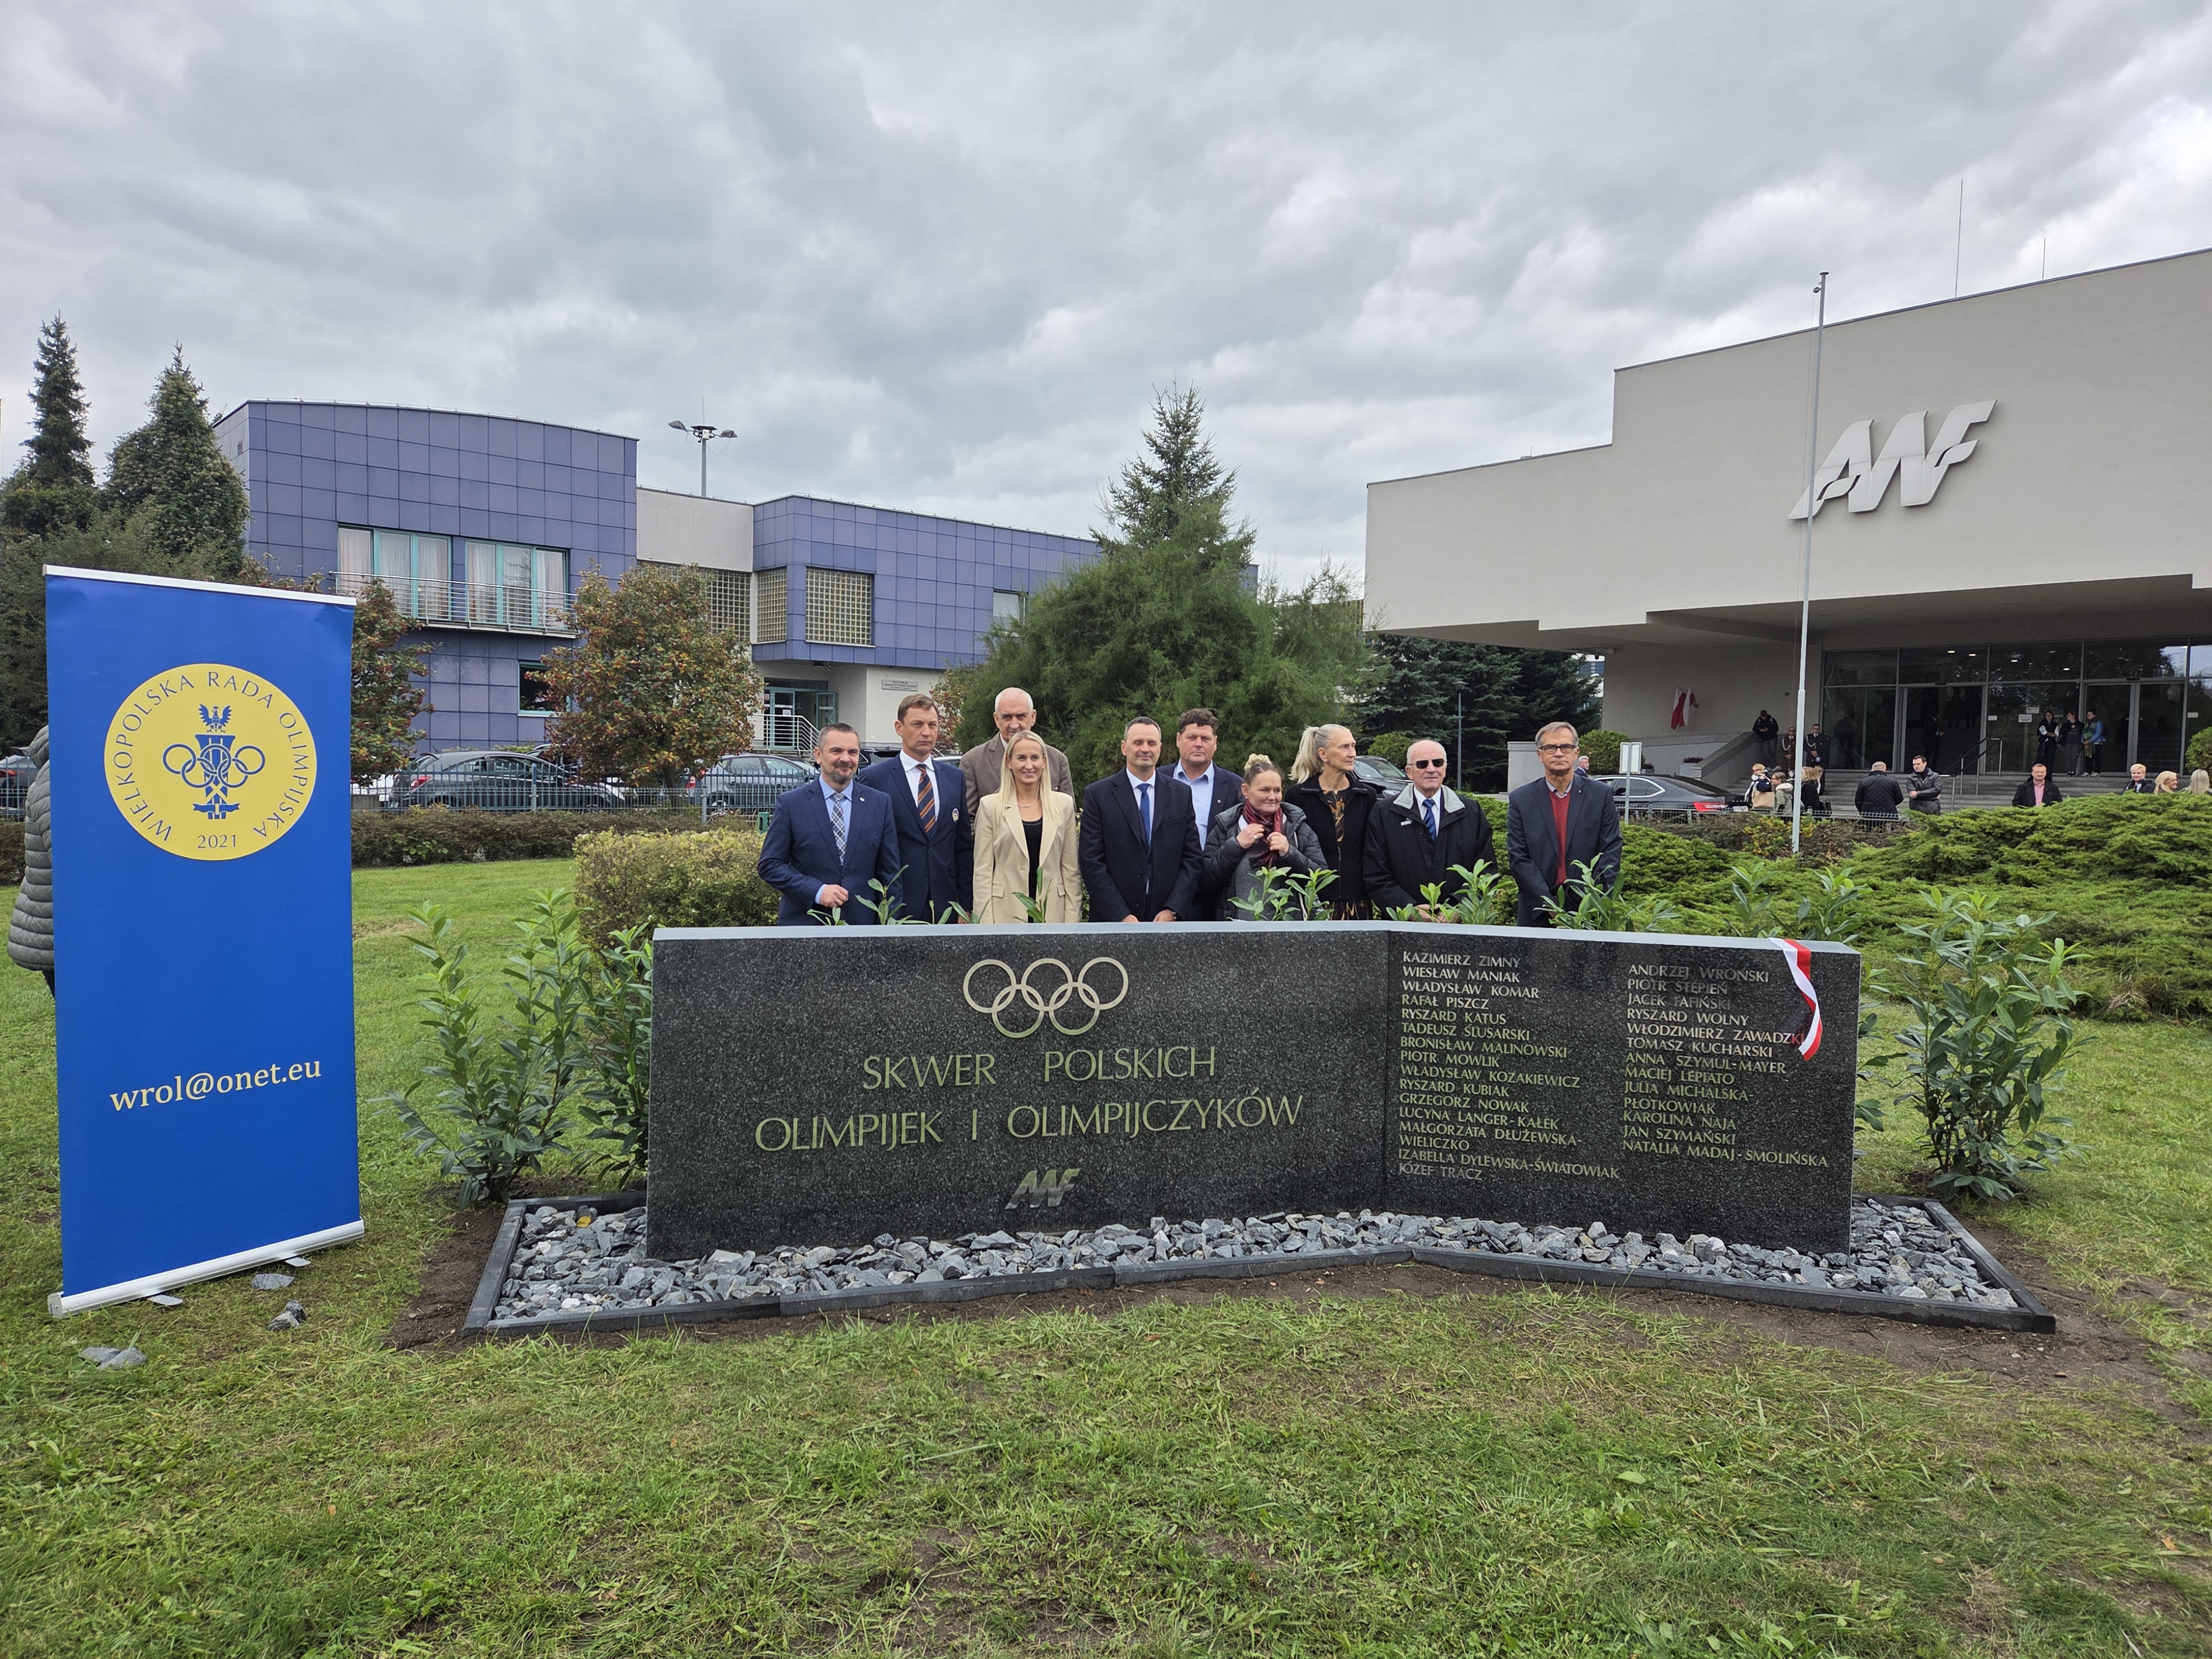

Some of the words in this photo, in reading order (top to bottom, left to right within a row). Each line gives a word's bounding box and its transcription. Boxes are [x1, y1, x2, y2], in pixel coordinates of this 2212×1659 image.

[113, 675, 195, 842] WIELKOPOLSKA
[208, 671, 273, 708] RADA
[253, 712, 309, 838] OLIMPIJSKA
[197, 834, 237, 849] 2021
[1403, 951, 1470, 966] KAZIMIERZ
[1479, 956, 1521, 968] ZIMNY
[1403, 966, 1460, 979] WIESŁAW
[1468, 969, 1520, 983] MANIAK
[1629, 964, 1689, 980] ANDRZEJ
[1402, 980, 1482, 994] WŁADYSŁAW
[1491, 986, 1539, 998] KOMAR
[1627, 979, 1667, 992] PIOTR
[1402, 994, 1439, 1006] RAFAŁ
[1447, 997, 1489, 1010] PISZCZ
[1627, 993, 1665, 1006] JACEK
[1674, 995, 1730, 1010] FAFIŃSKI
[1402, 1009, 1457, 1022] RYSZARD
[1465, 1012, 1506, 1025] KATUS
[1627, 1009, 1687, 1022] RYSZARD
[1697, 1012, 1749, 1026] WOLNY
[1401, 1022, 1457, 1036] TADEUSZ
[1464, 1025, 1530, 1041] ŚLUSARSKI
[1627, 1022, 1724, 1040] WŁODZIMIERZ
[1400, 1037, 1474, 1052] BRONISŁAW
[1482, 1042, 1567, 1058] MALINOWSKI
[1626, 1037, 1683, 1052] TOMASZ
[1692, 1042, 1772, 1057] KUCHARSKI
[1400, 1051, 1437, 1063] PIOTR
[1446, 1053, 1500, 1068] MOWLIK
[1626, 1052, 1665, 1066] ANNA
[863, 1053, 995, 1090] SKWER
[1044, 1046, 1216, 1082] POLSKICH
[1400, 1065, 1481, 1079] WŁADYSŁAW
[1489, 1071, 1580, 1088] KOZAKIEWICZ
[1625, 1067, 1672, 1082] MACIEJ
[109, 1061, 321, 1111] wrol@onet.eu
[1400, 1079, 1455, 1093] RYSZARD
[1463, 1083, 1510, 1097] KUBIAK
[1625, 1081, 1658, 1094] JULIA
[1667, 1086, 1754, 1102] MICHALSKA-
[1400, 1093, 1471, 1108] GRZEGORZ
[1479, 1099, 1529, 1113] NOWAK
[1624, 1098, 1716, 1115] PŁOTKOWIAK
[755, 1110, 943, 1152] OLIMPIJEK
[972, 1109, 977, 1140] I
[1007, 1088, 1303, 1138] OLIMPIJCZYKÓW
[1400, 1107, 1450, 1121] LUCYNA
[1624, 1110, 1693, 1126] KAROLINA
[1702, 1117, 1736, 1130] NAJA
[1399, 1121, 1486, 1138] MAŁGORZATA
[1495, 1129, 1582, 1146] DŁUŻEWSKA-
[1624, 1125, 1649, 1138] JAN
[1656, 1128, 1736, 1145] SZYMAŃSKI
[1399, 1135, 1470, 1151] WIELICZKO
[1623, 1139, 1679, 1156] NATALIA
[1399, 1148, 1454, 1164] IZABELLA
[1399, 1160, 1434, 1176] JÓZEF
[1442, 1166, 1483, 1180] TRACZ
